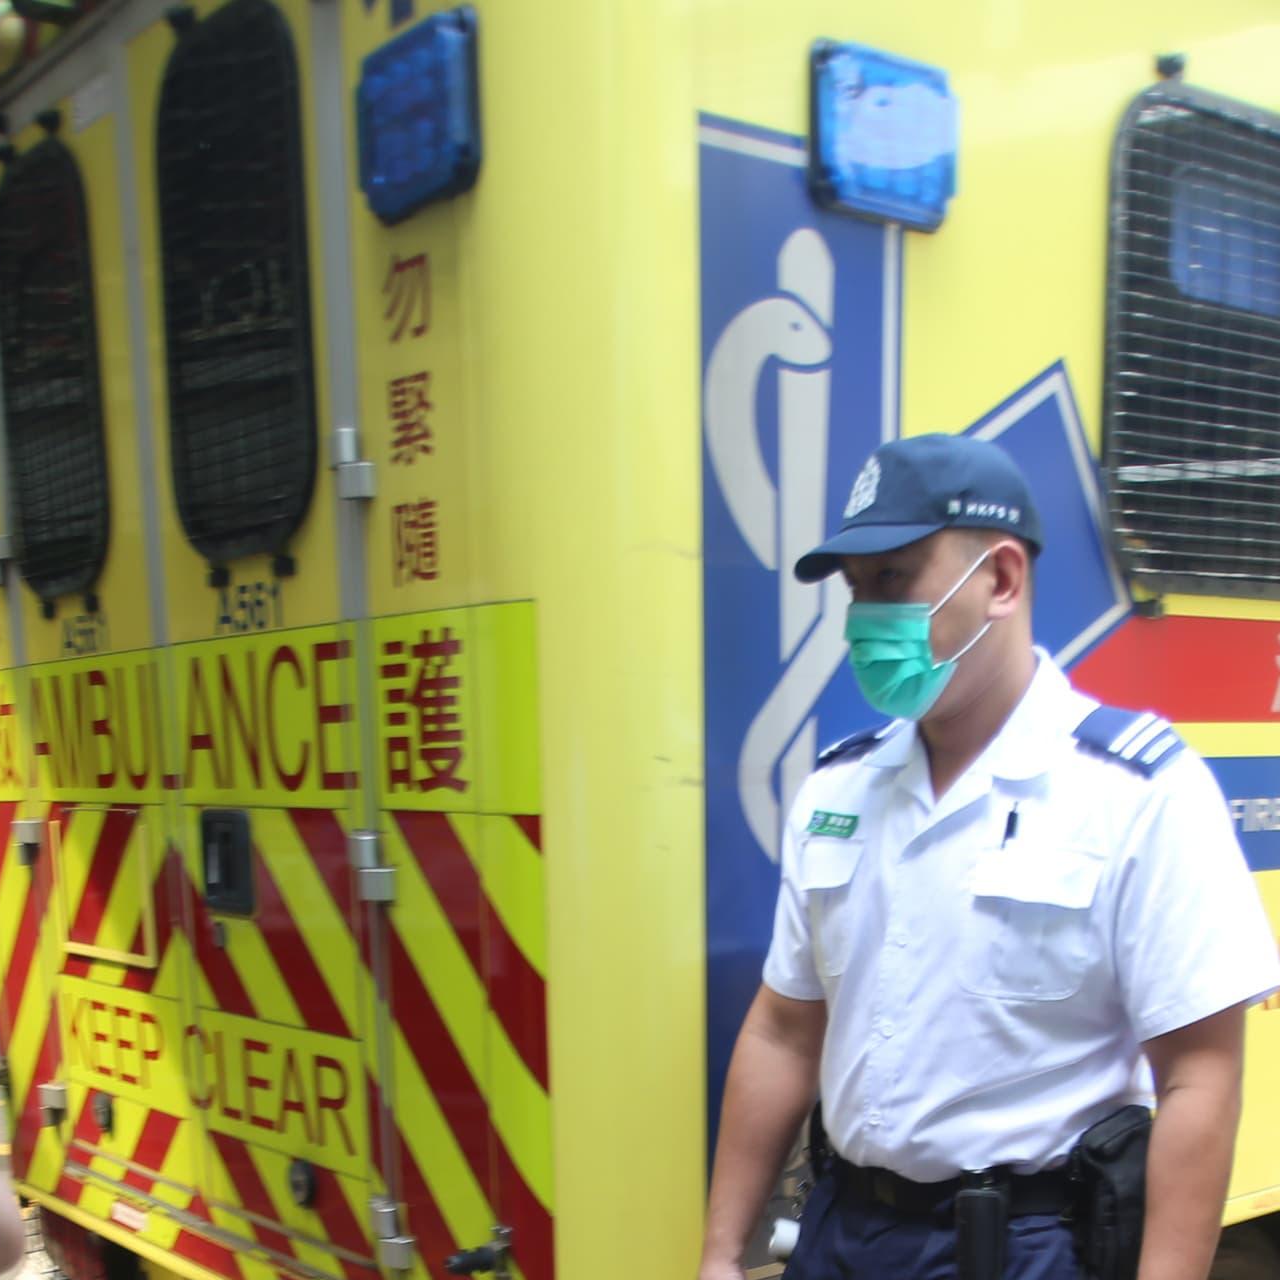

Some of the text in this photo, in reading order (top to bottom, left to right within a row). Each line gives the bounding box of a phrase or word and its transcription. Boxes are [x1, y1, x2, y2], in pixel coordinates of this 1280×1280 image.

[28, 644, 358, 791] AMBULANCE
[380, 628, 468, 793] 護
[65, 995, 358, 1156] KEEP CLEAR
